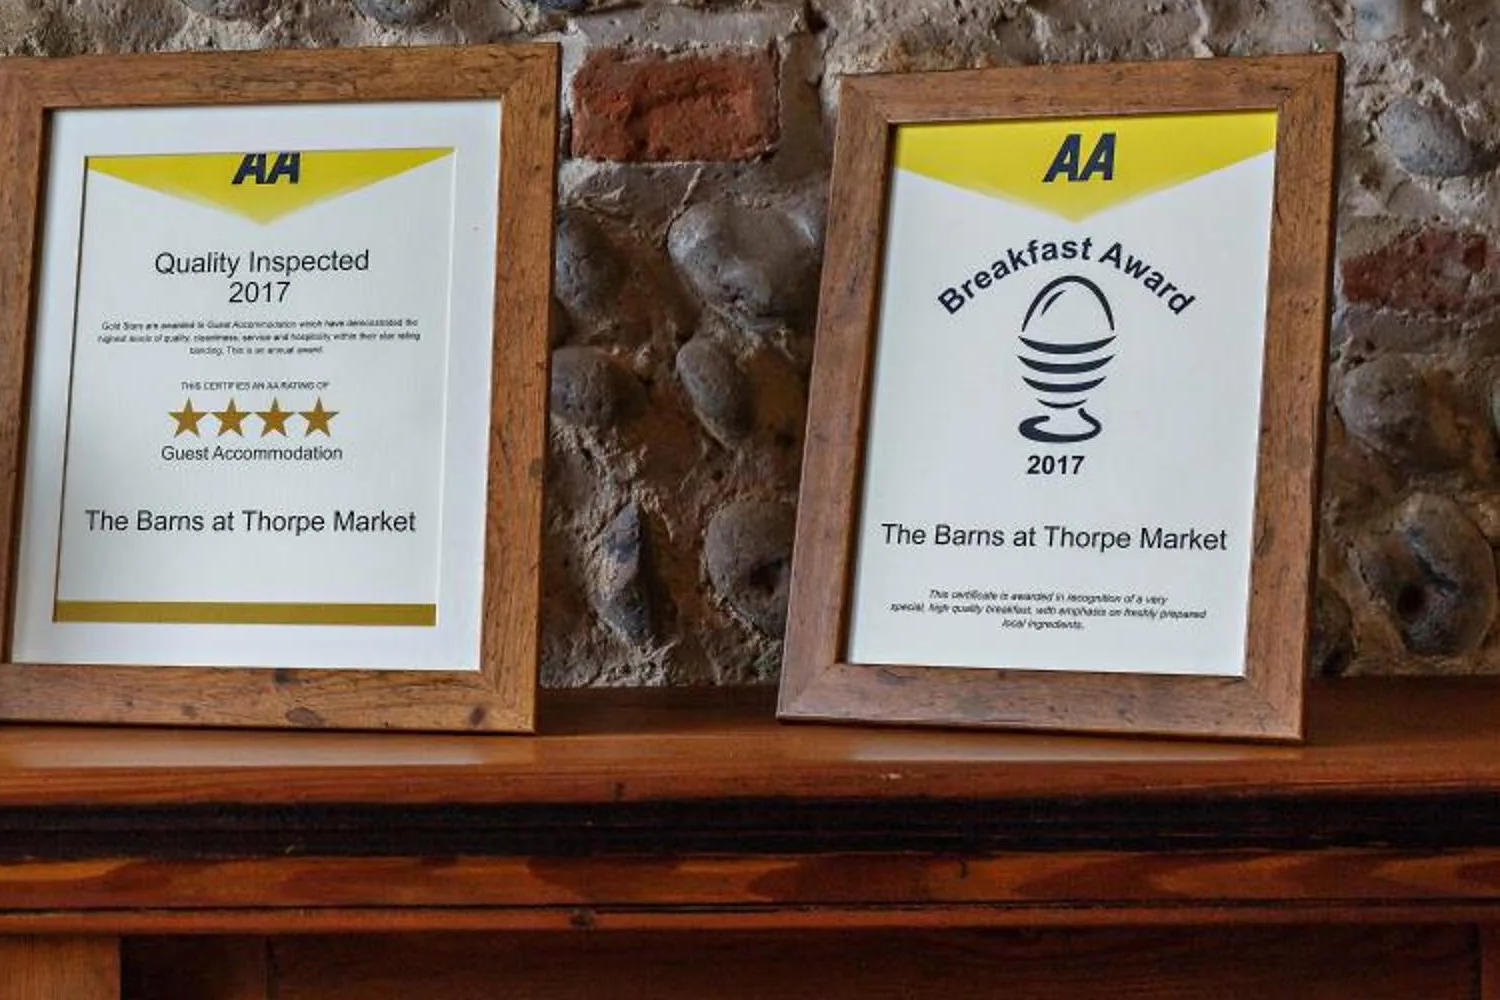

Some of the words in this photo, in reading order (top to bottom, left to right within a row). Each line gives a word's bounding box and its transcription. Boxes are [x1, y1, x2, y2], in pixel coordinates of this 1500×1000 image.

[1043, 132, 1116, 182] AA
[232, 152, 299, 184] AA
[155, 252, 239, 278] Quality
[249, 250, 369, 277] Inspected
[937, 237, 1092, 314] Breakfast
[1098, 242, 1195, 314] Award
[229, 281, 290, 303] 2017
[102, 322, 120, 330] Gold
[300, 320, 323, 328] which
[324, 320, 344, 328] have
[181, 382, 202, 390] THIS
[252, 381, 265, 390] AN
[266, 381, 279, 390] AA
[279, 381, 315, 390] RATING
[316, 381, 329, 390] OF
[161, 446, 210, 461] Guest
[212, 445, 343, 461] Accommodation
[1027, 455, 1084, 475] 2017
[85, 510, 128, 531] The
[136, 510, 205, 532] Barns
[212, 512, 234, 532] at
[242, 510, 325, 536] Thorpe
[333, 510, 416, 532] Market
[881, 523, 927, 545] The
[934, 524, 1005, 547] Barns
[1013, 527, 1036, 547] at
[1044, 526, 1131, 552] Thorpe
[1140, 527, 1228, 550] Market
[930, 589, 949, 599] This
[952, 589, 998, 600] certificate
[1011, 591, 1055, 601] awarded
[1056, 592, 1064, 600] in
[1067, 592, 1121, 604] recognition
[1124, 593, 1135, 603] of
[1145, 596, 1168, 605] very
[952, 604, 984, 615] quality
[1159, 610, 1206, 621] prepared
[1002, 618, 1026, 628] local
